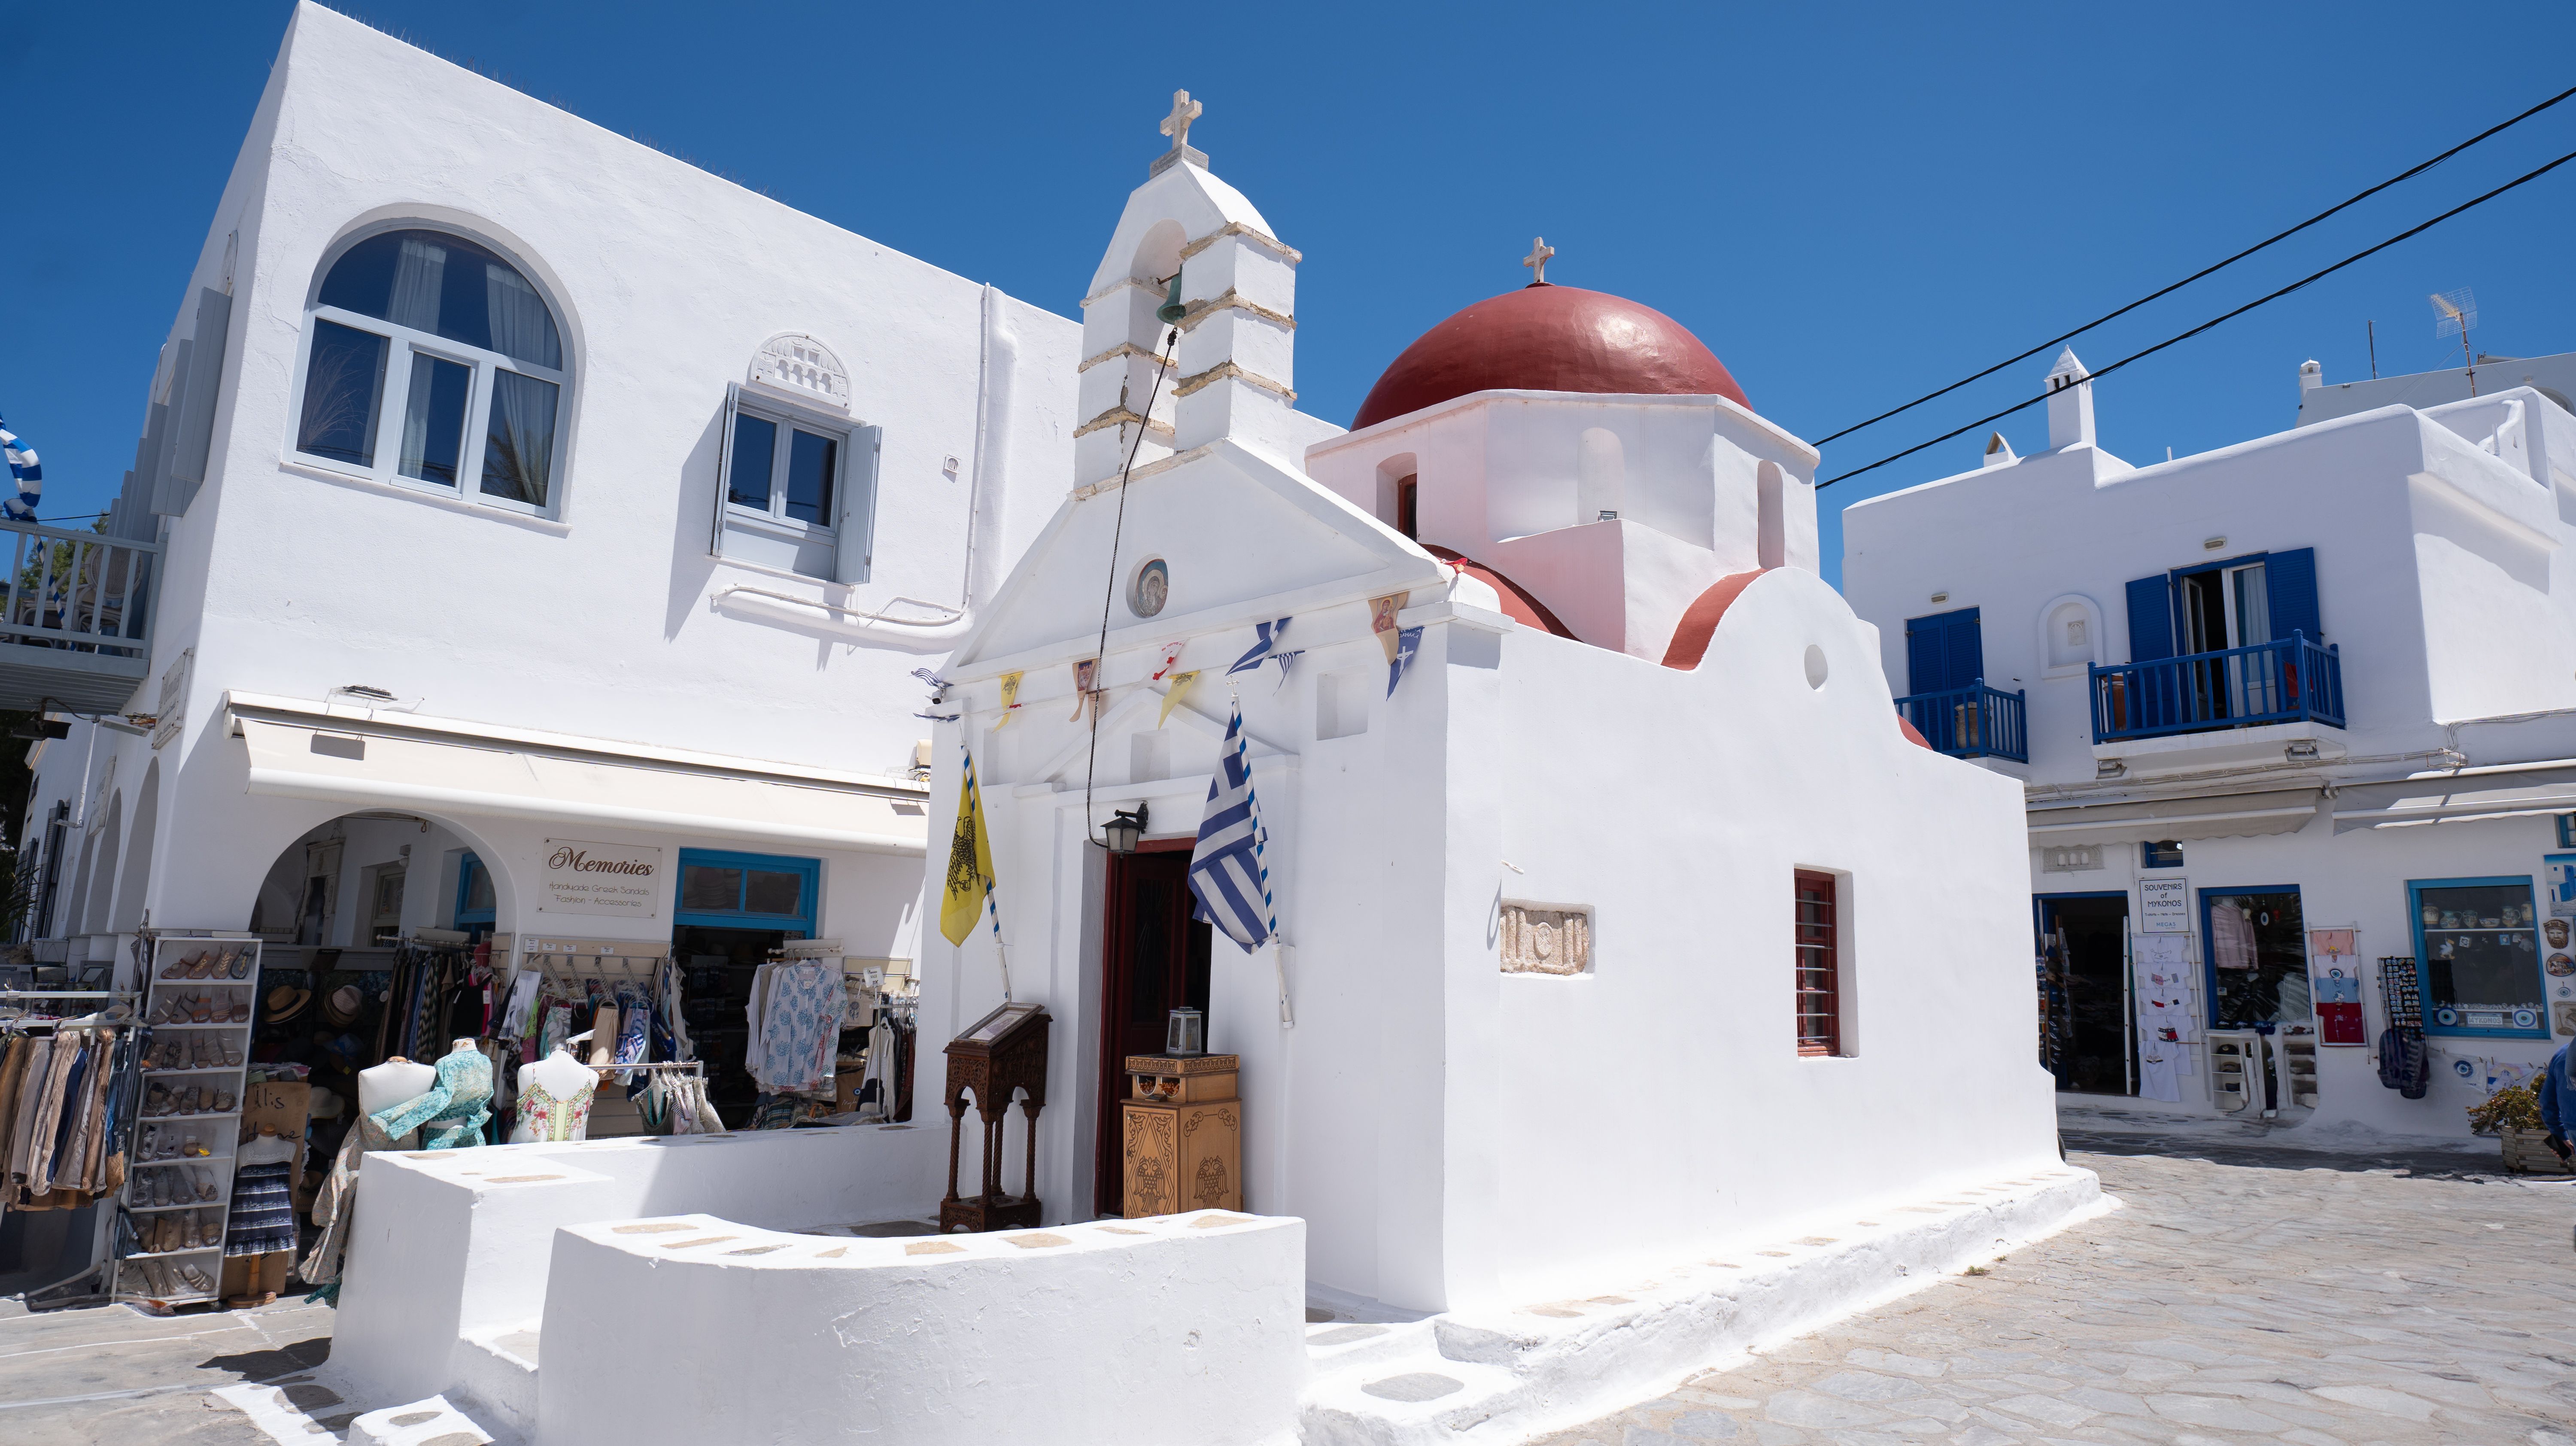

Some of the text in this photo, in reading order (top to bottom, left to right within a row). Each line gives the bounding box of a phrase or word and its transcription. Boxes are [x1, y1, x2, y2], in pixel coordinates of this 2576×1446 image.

[549, 847, 654, 876] Memories
[592, 884, 618, 893] Greek
[620, 886, 649, 896] Sandals
[554, 894, 586, 904] Fashion
[594, 897, 642, 907] Accessories
